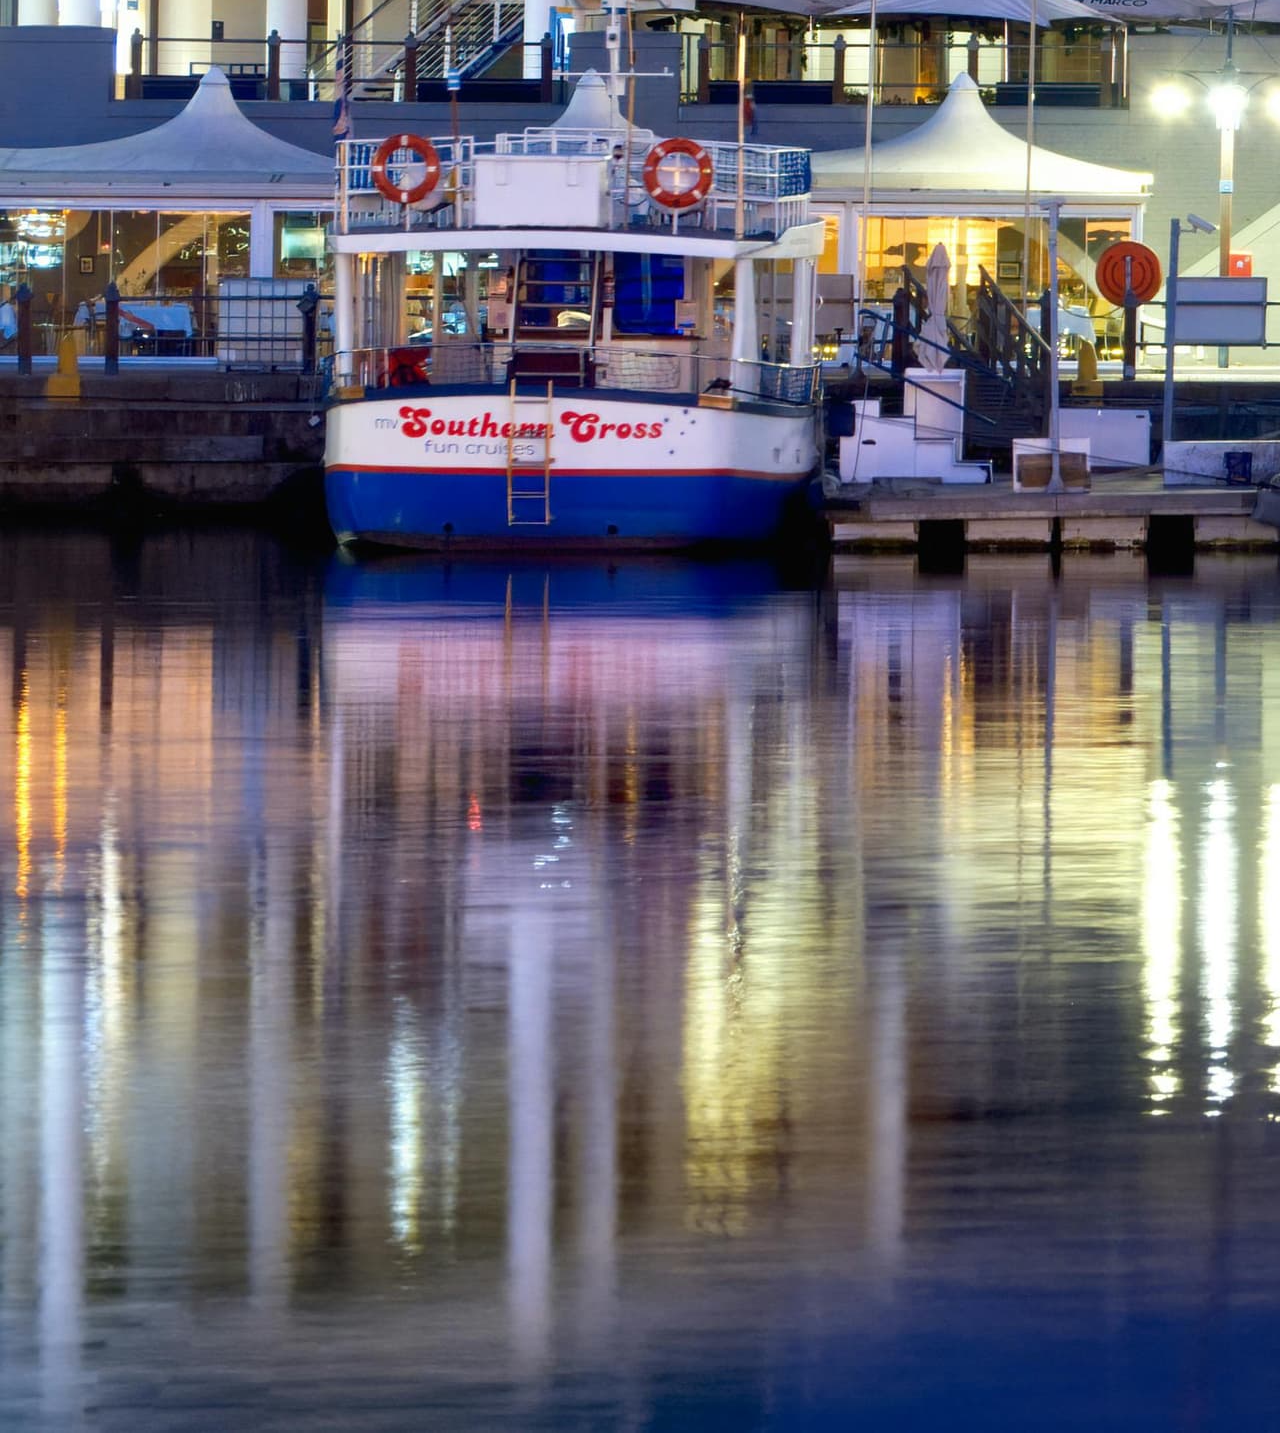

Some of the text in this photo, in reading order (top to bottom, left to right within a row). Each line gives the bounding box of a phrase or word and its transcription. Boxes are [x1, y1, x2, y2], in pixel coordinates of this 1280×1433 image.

[399, 405, 556, 439] Southern
[560, 410, 664, 444] Cross
[424, 438, 536, 456] fun cruises
